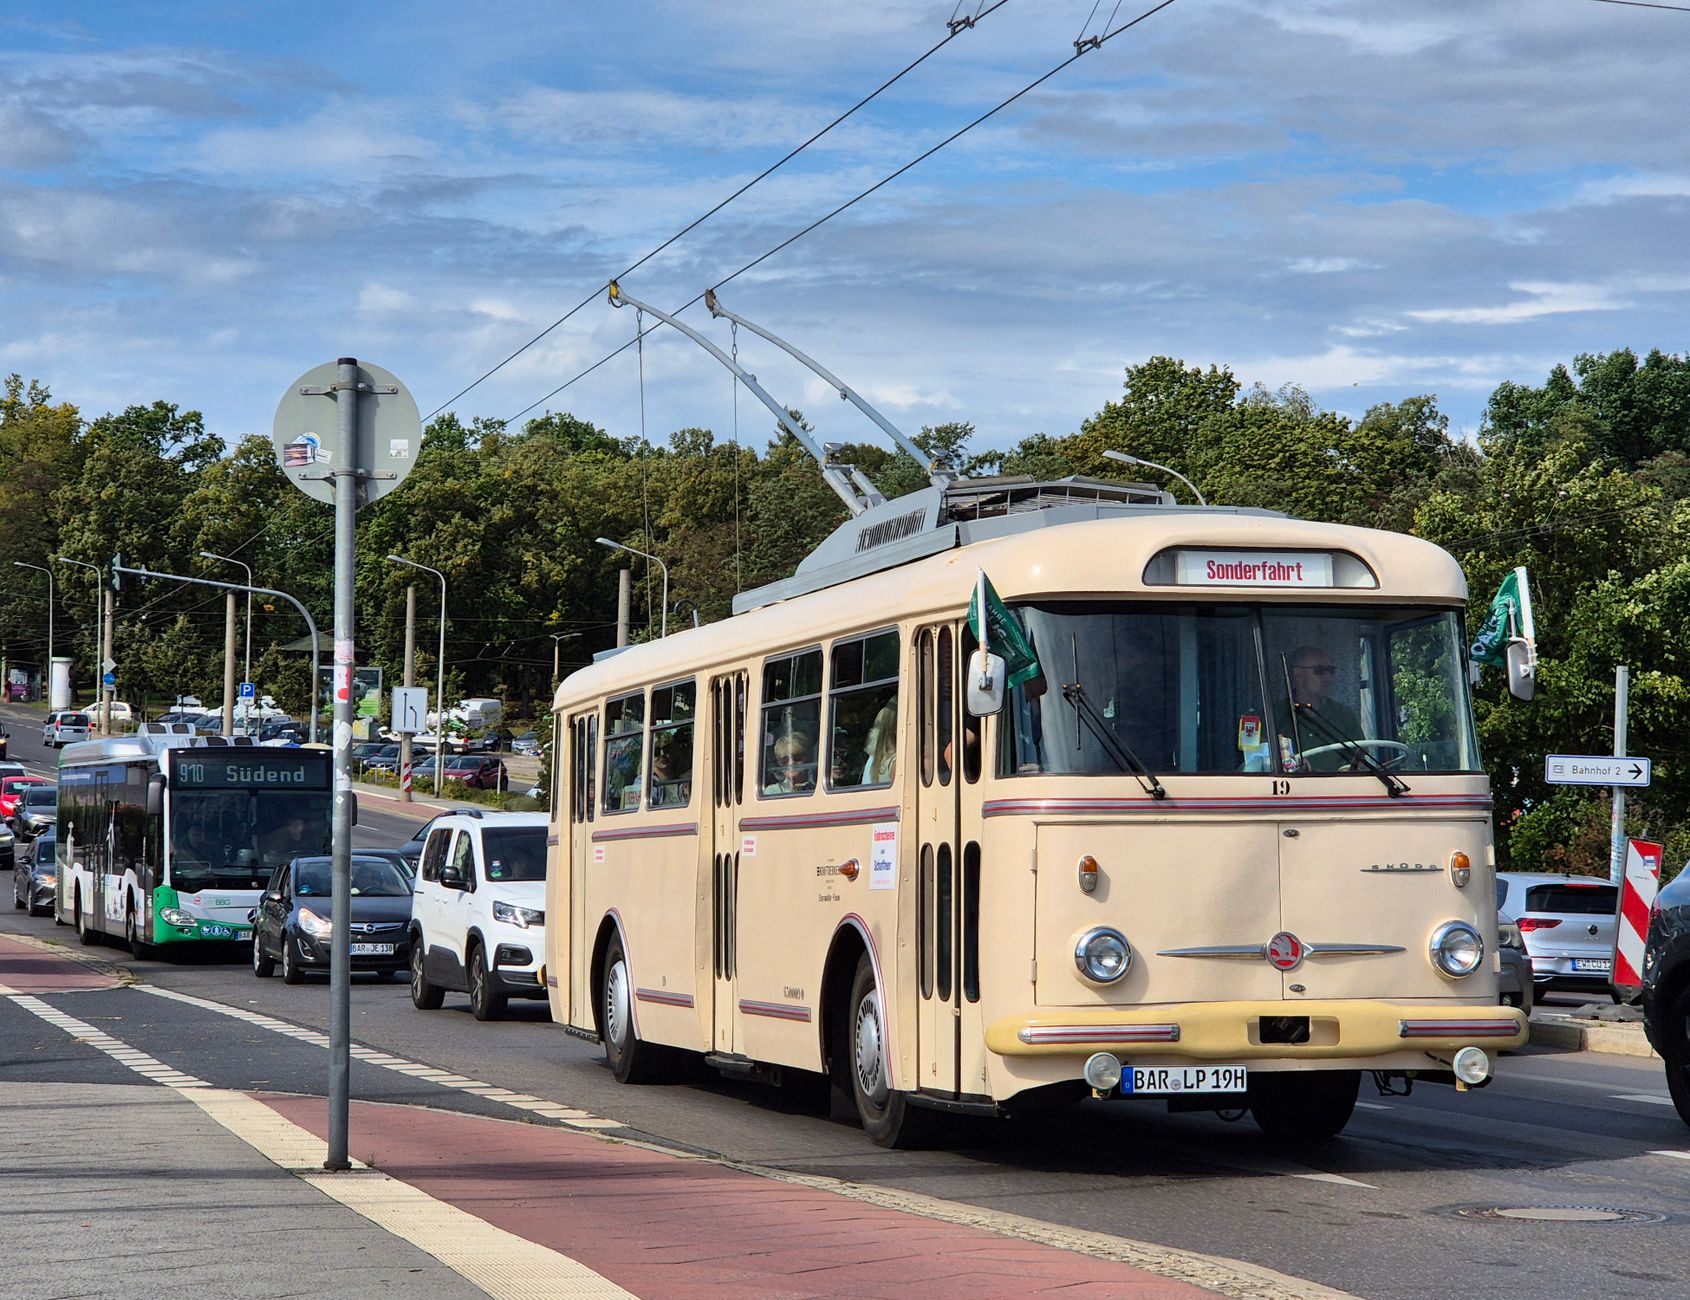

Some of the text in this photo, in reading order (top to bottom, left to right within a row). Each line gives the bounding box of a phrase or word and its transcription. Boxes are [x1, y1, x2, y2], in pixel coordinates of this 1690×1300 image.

[1206, 559, 1303, 581] Sonderfahrt
[243, 684, 252, 696] P
[179, 763, 305, 783] 910 Südend
[1572, 765, 1621, 776] Bahnhof 2
[1272, 780, 1290, 795] 19
[352, 944, 366, 952] BAR
[1134, 1069, 1169, 1090] BAR
[1183, 1069, 1206, 1089] LP
[1211, 1069, 1245, 1089] 19H
